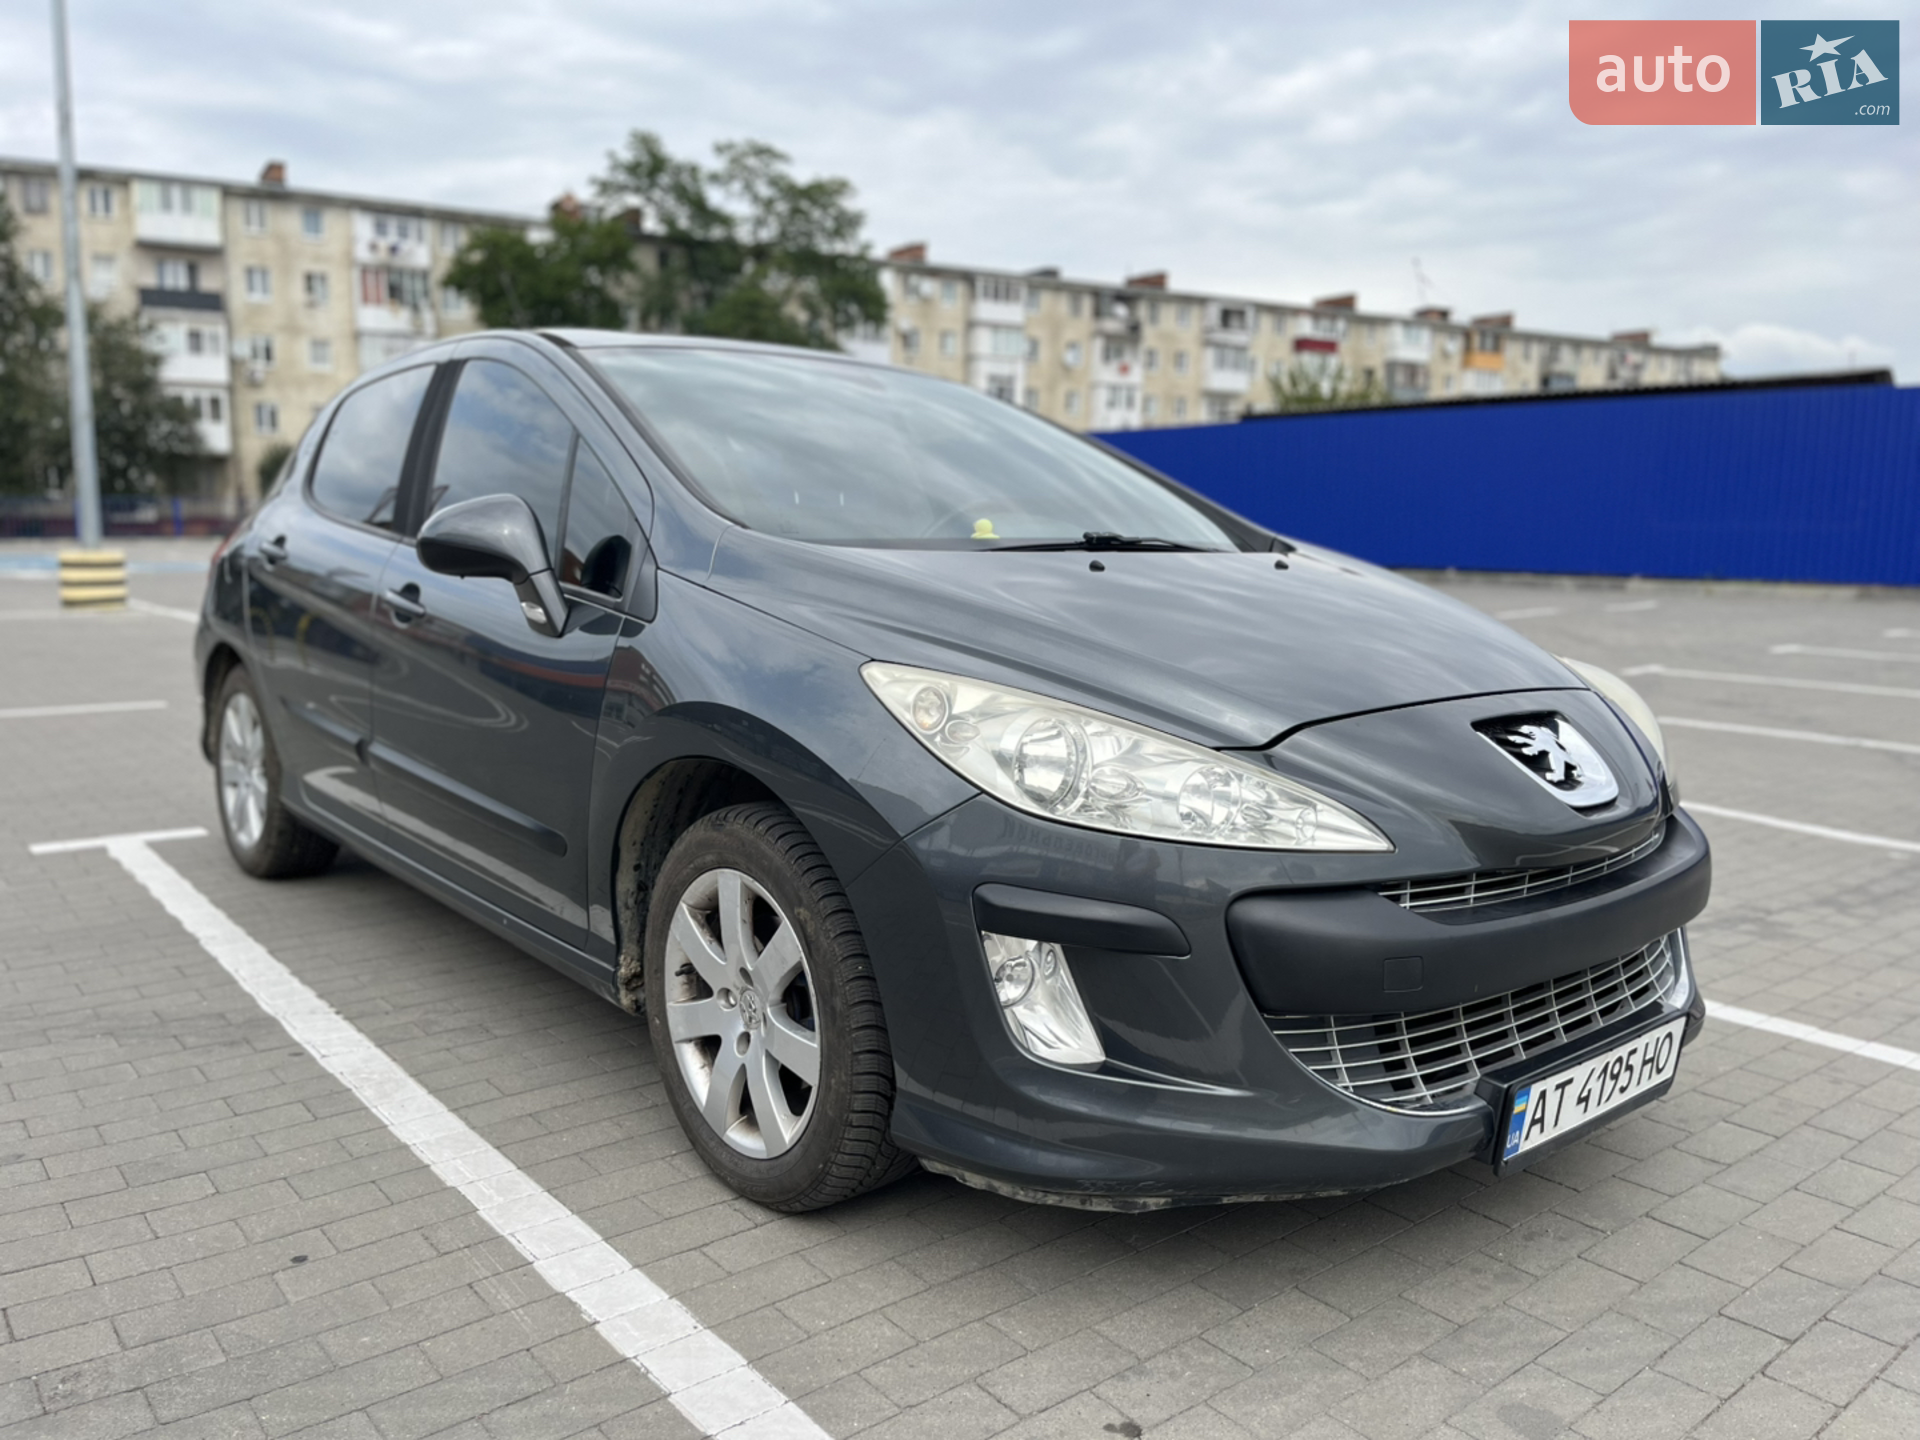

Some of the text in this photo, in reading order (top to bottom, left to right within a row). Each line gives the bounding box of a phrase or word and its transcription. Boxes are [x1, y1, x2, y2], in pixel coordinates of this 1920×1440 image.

[1523, 1031, 1674, 1141] AT 4195 HO
[1506, 1130, 1520, 1149] UA
